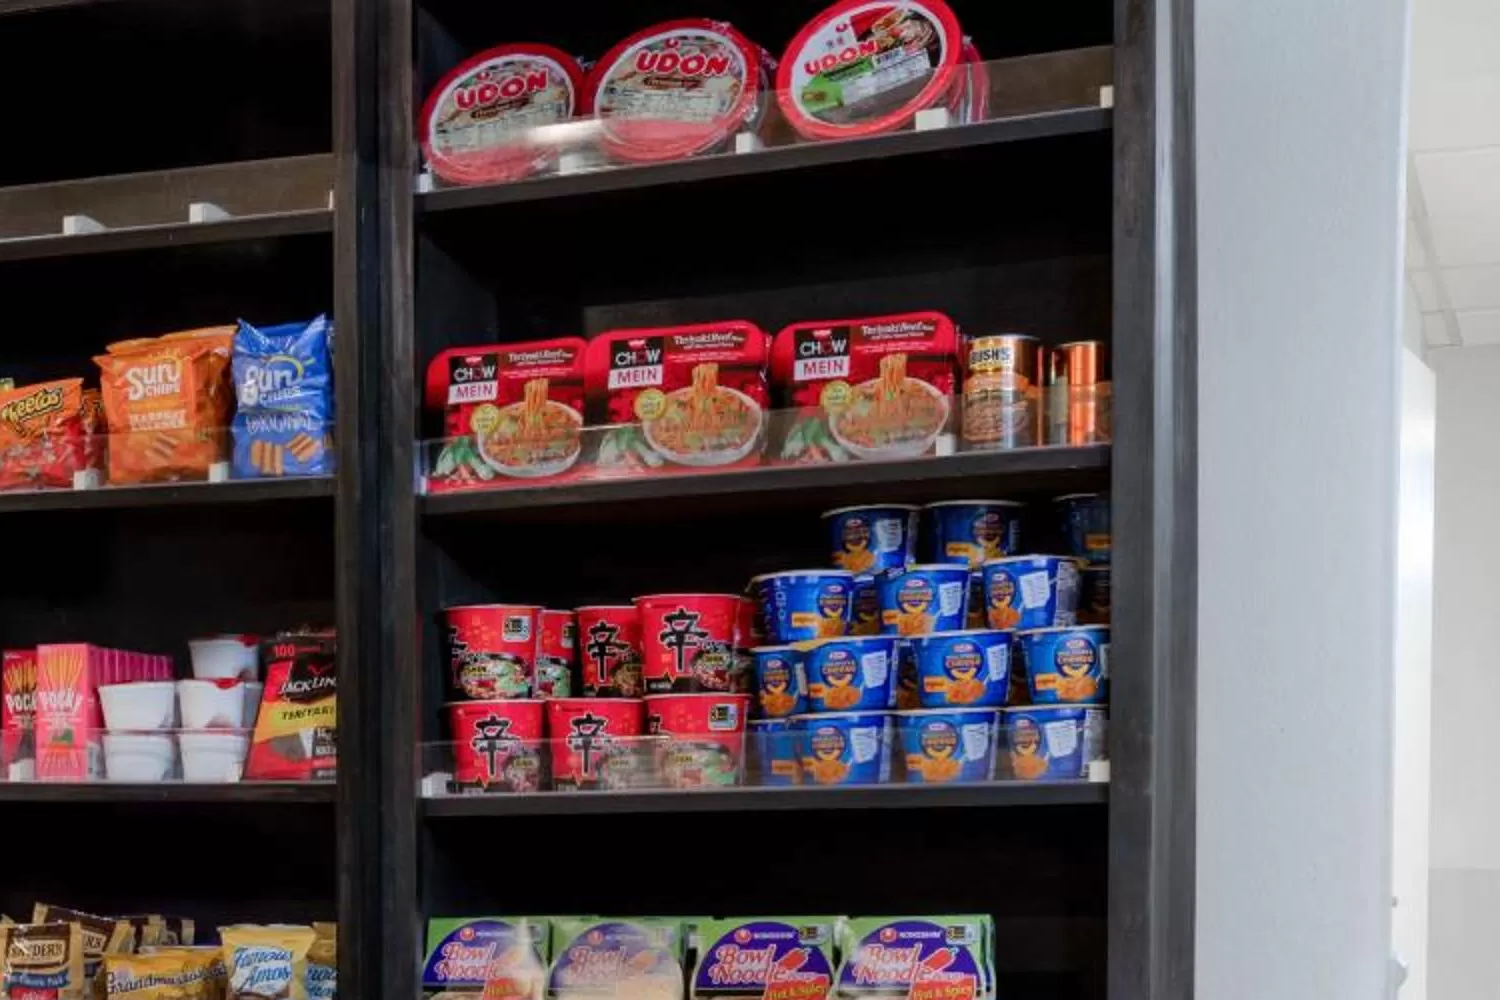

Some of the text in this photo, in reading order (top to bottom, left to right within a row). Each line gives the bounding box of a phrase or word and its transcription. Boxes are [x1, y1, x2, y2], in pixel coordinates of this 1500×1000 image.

[635, 49, 731, 77] UDON
[803, 39, 879, 76] UDON
[454, 68, 549, 111] UDON
[799, 338, 847, 356] CHOW
[615, 348, 660, 366] CHOW
[453, 365, 496, 382] CHOW
[616, 367, 658, 385] MEIN
[802, 358, 844, 376] MEIN
[124, 360, 180, 401] Sun
[455, 381, 493, 399] MEIN
[660, 607, 710, 673] 辛
